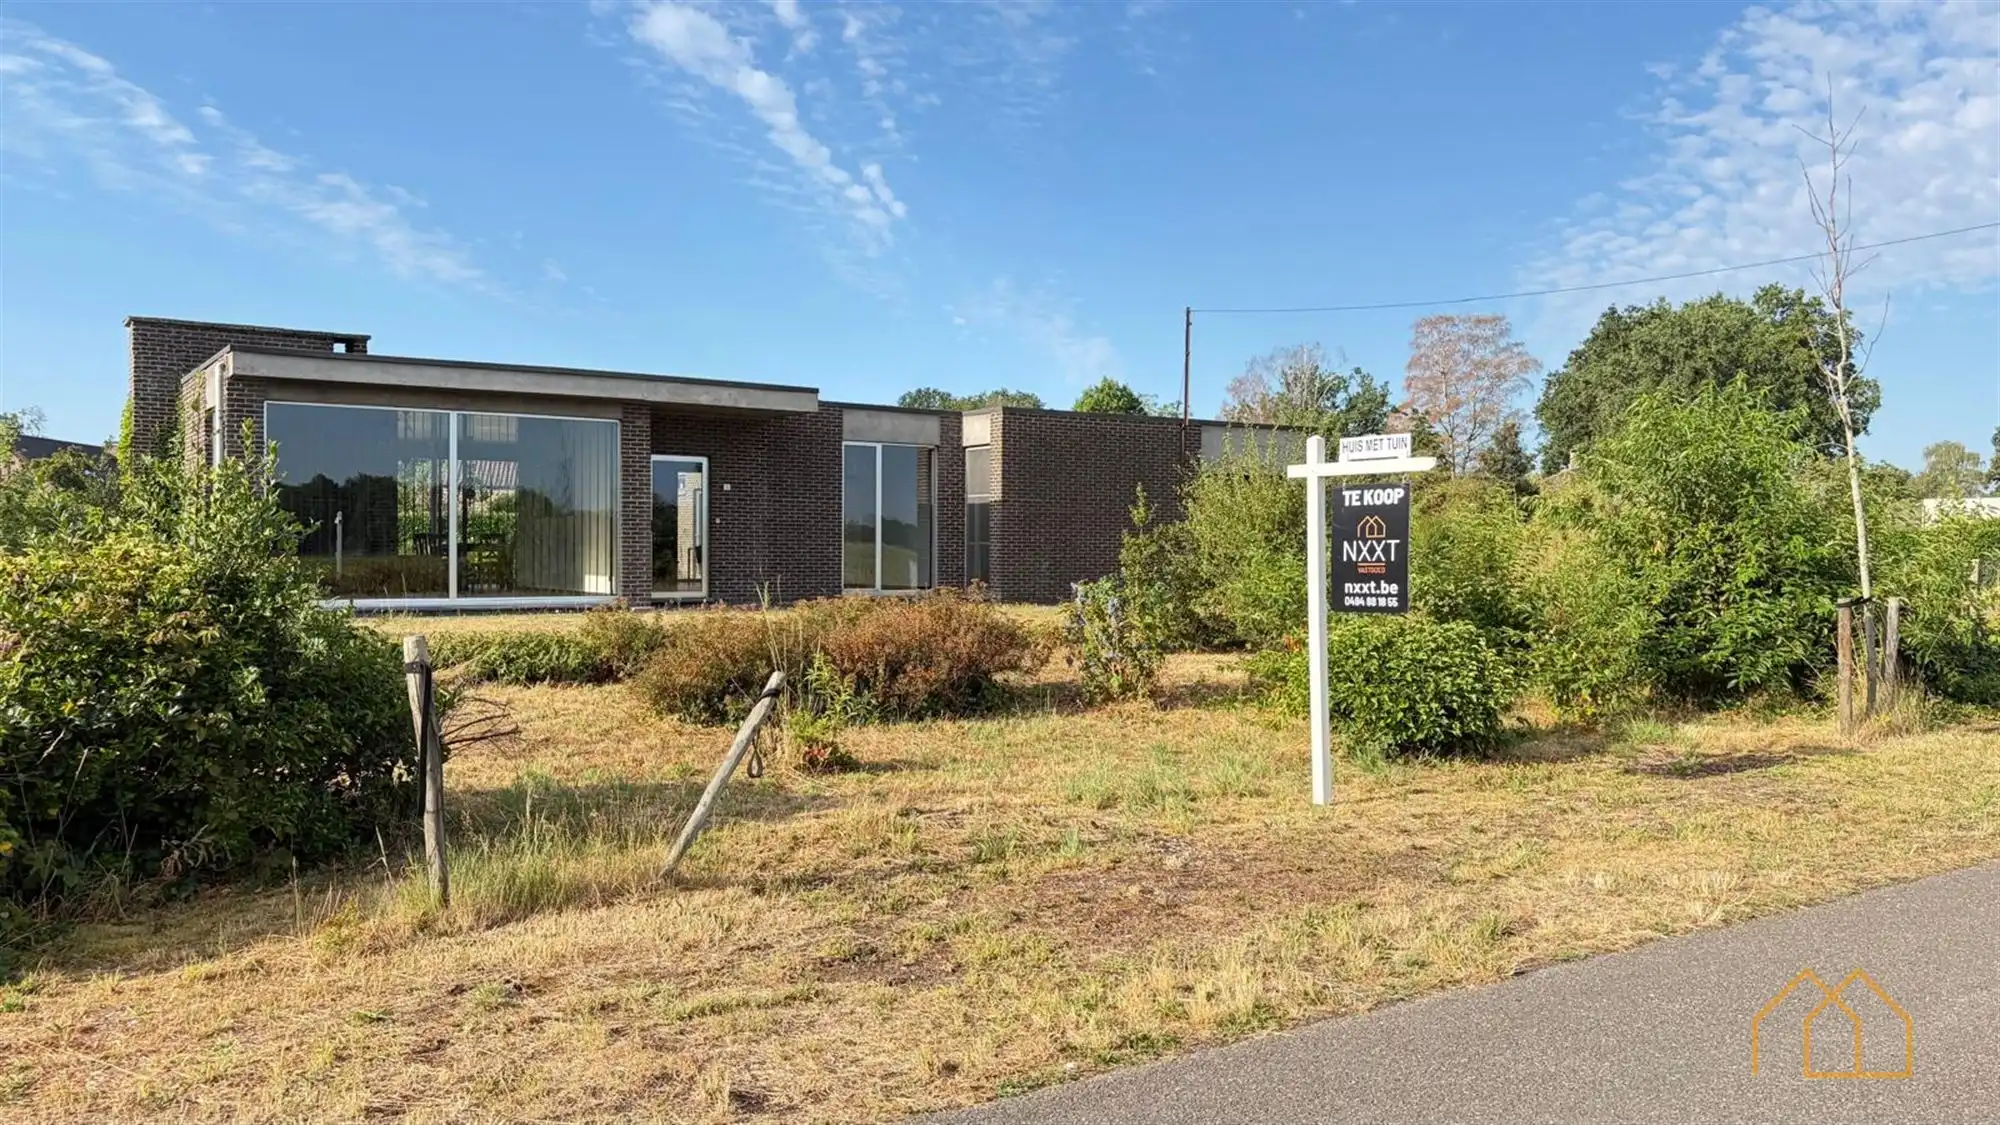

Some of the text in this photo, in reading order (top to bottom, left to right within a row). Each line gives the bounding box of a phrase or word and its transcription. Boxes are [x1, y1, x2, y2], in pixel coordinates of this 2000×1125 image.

[1342, 436, 1407, 453] HUIS MET TUIN
[1342, 488, 1405, 507] TE KOOP
[1343, 540, 1400, 563] NXXT
[1344, 580, 1399, 595] nxxt.be
[1387, 597, 1399, 608] 55
